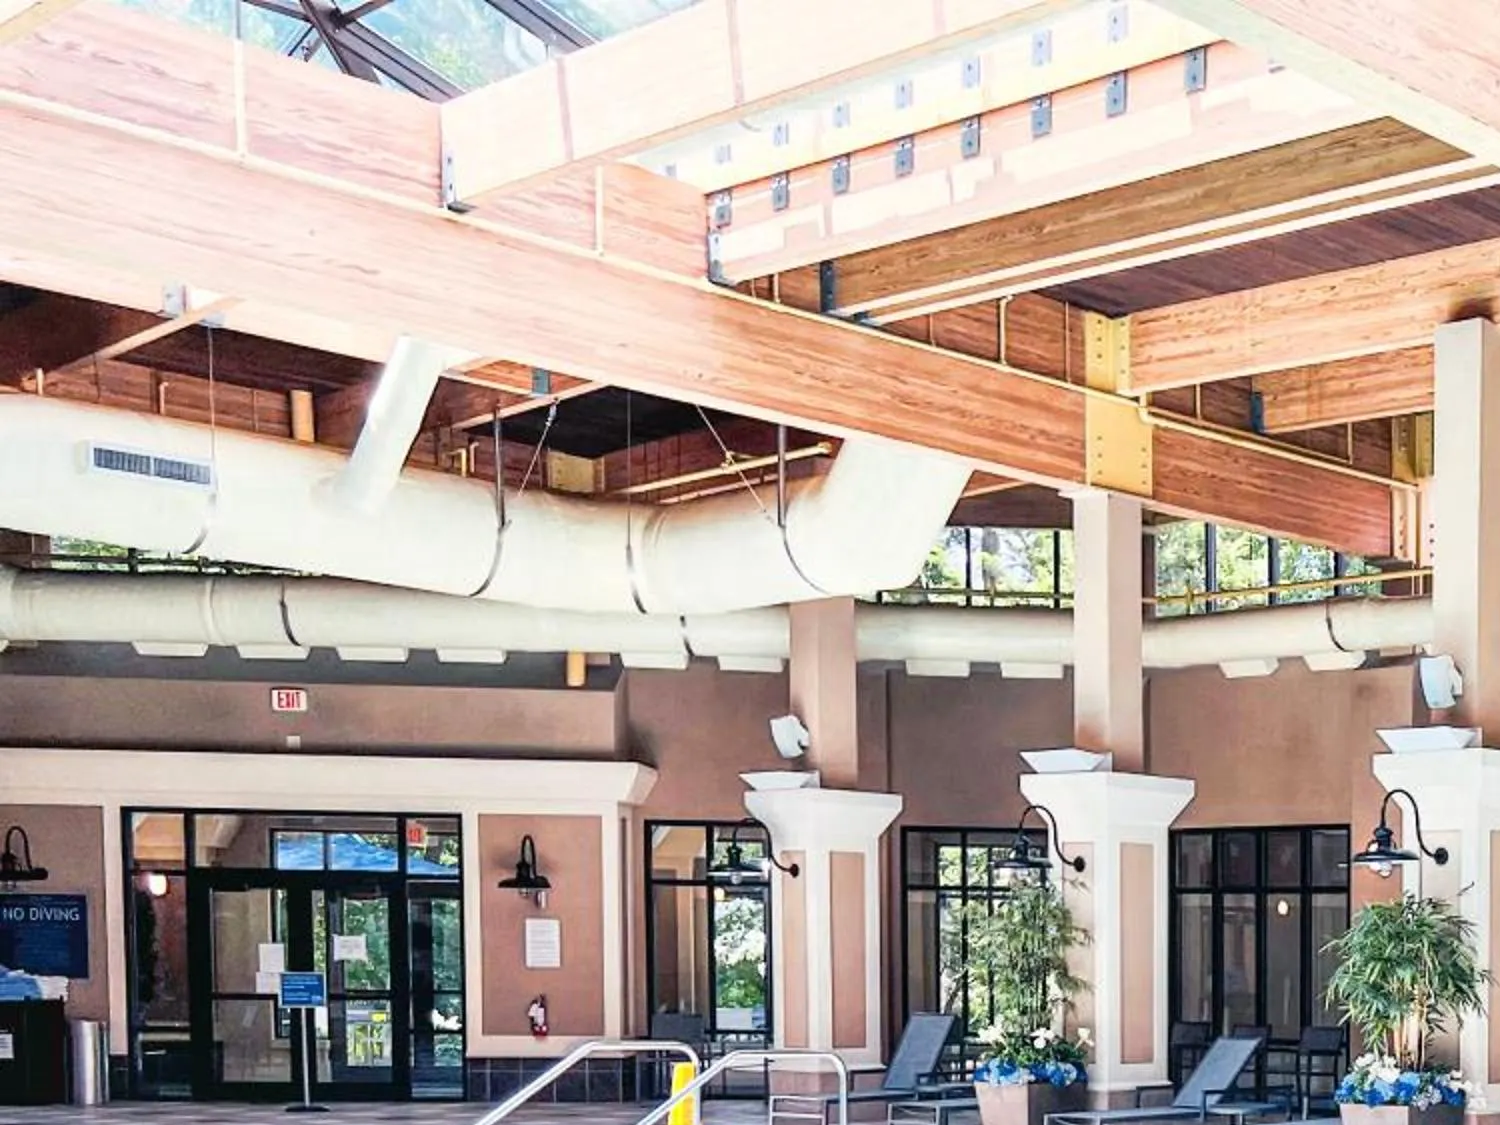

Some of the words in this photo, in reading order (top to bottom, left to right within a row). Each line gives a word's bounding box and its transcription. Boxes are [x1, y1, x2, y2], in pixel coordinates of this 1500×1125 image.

[277, 691, 301, 709] EXIT
[3, 907, 25, 921] NO
[29, 907, 80, 921] DIVING
